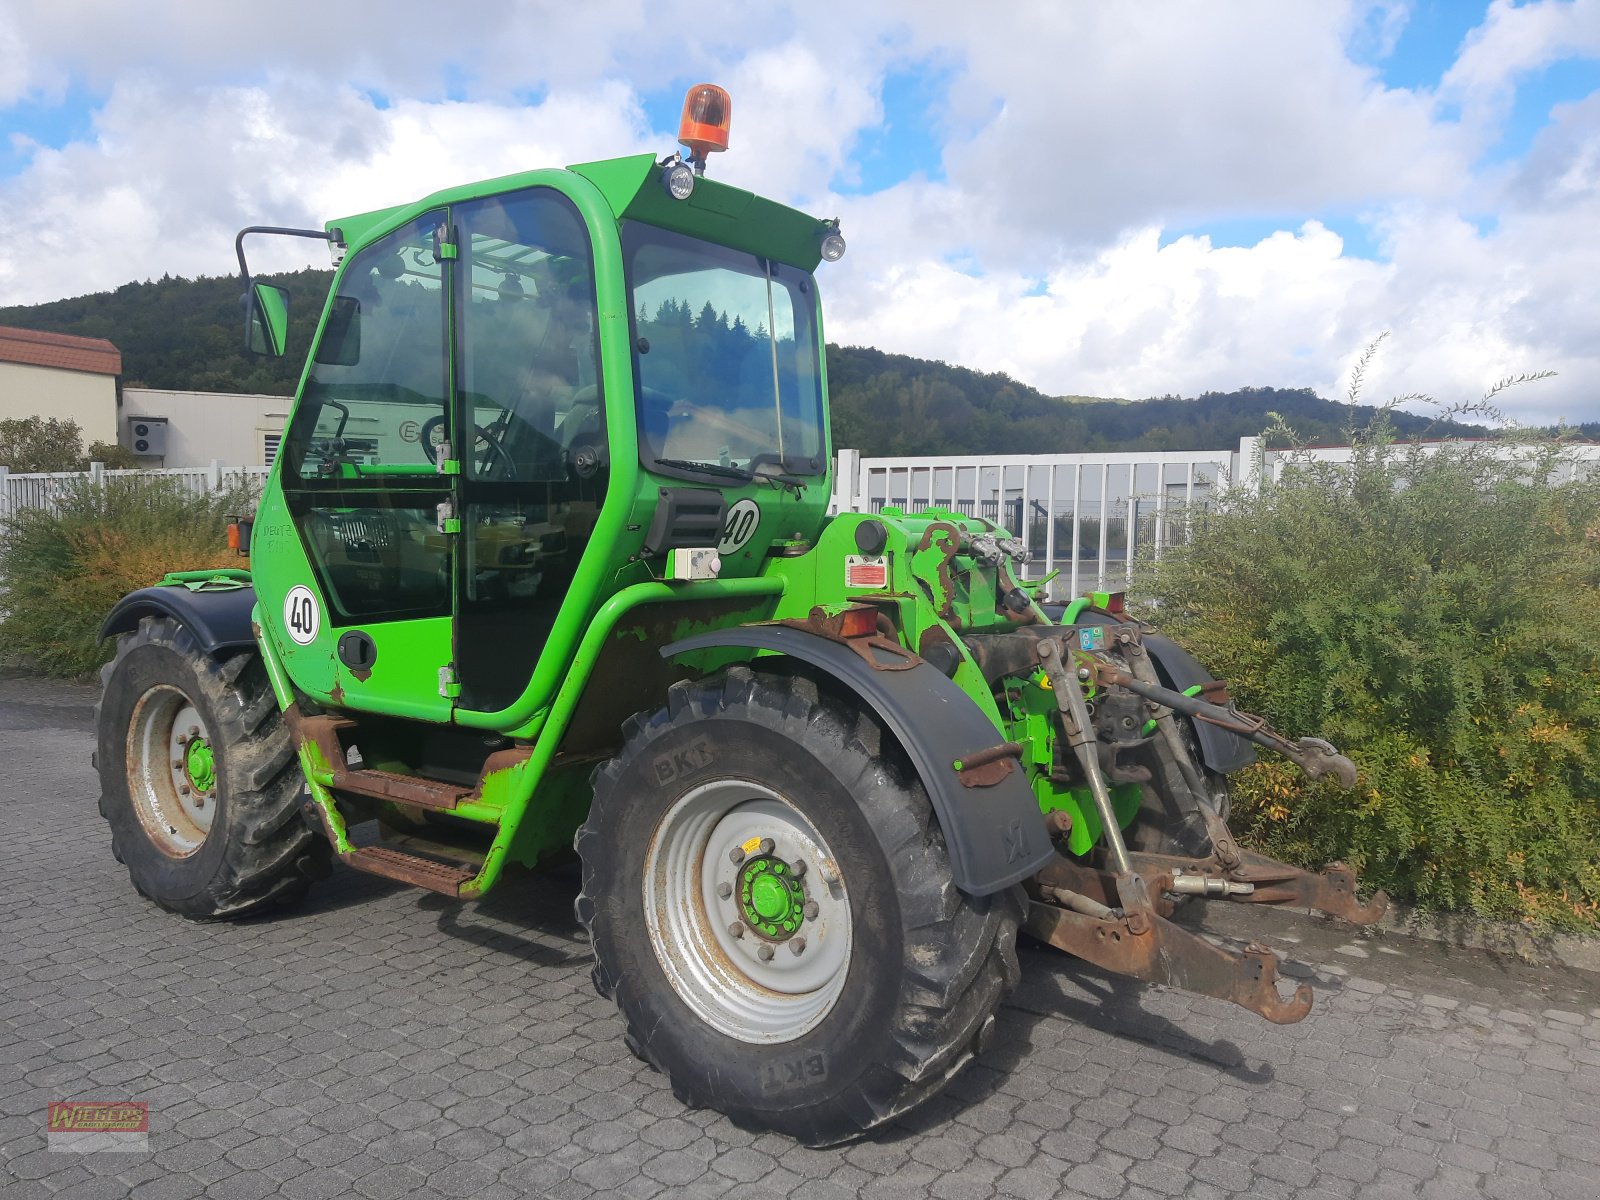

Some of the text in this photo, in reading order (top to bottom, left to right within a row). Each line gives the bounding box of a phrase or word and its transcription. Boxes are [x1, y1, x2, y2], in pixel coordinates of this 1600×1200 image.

[720, 509, 755, 545] 40
[290, 596, 313, 635] 40
[655, 741, 713, 783] BKT
[763, 1053, 826, 1090] BKT
